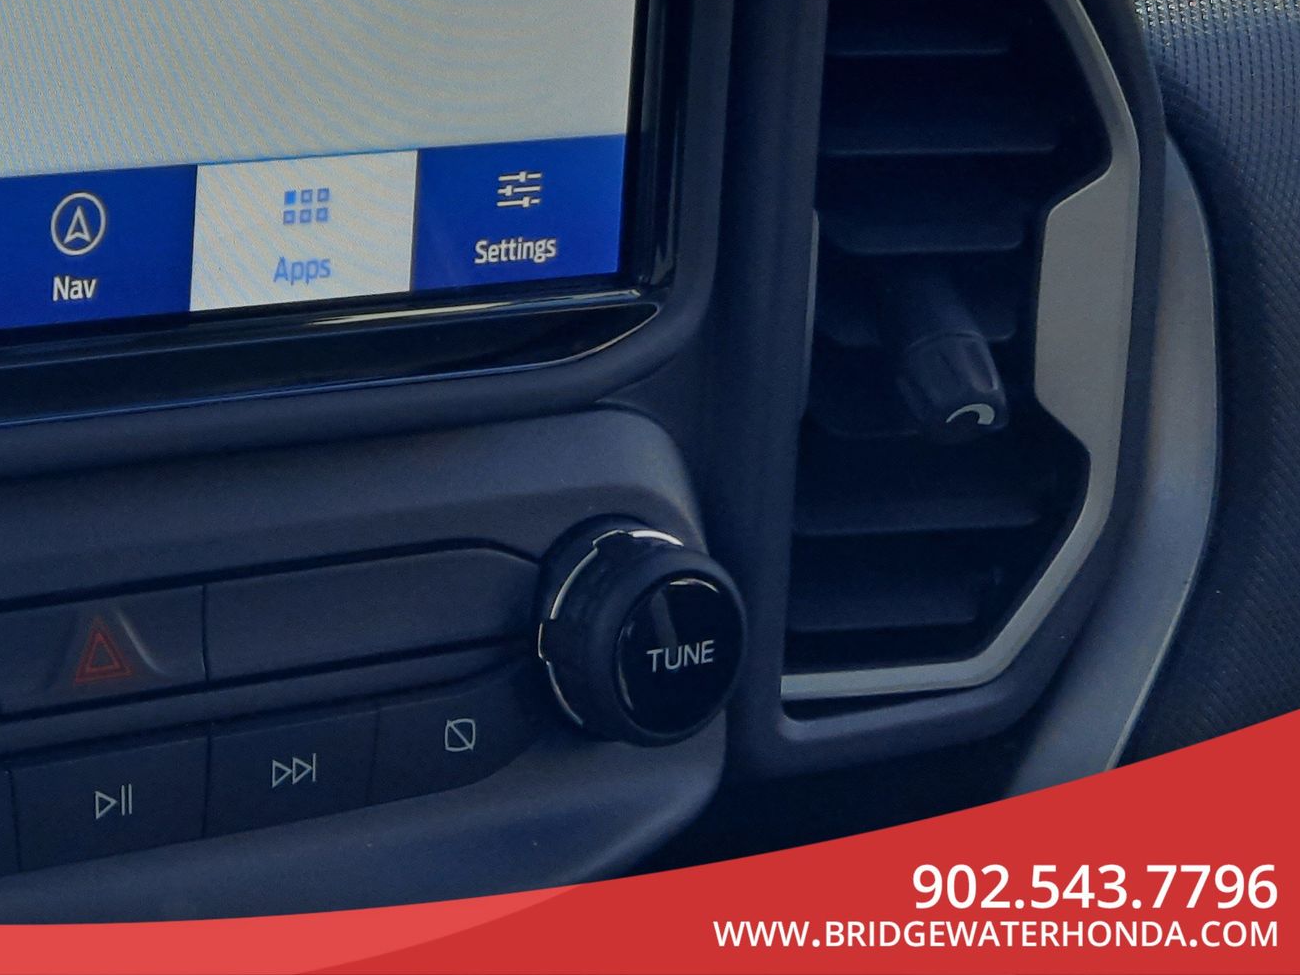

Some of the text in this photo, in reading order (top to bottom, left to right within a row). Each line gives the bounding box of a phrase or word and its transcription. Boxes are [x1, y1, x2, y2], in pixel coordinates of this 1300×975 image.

[474, 235, 557, 265] Settings
[273, 255, 332, 287] Apps
[52, 276, 97, 302] Nav
[646, 640, 715, 673] TUNE
